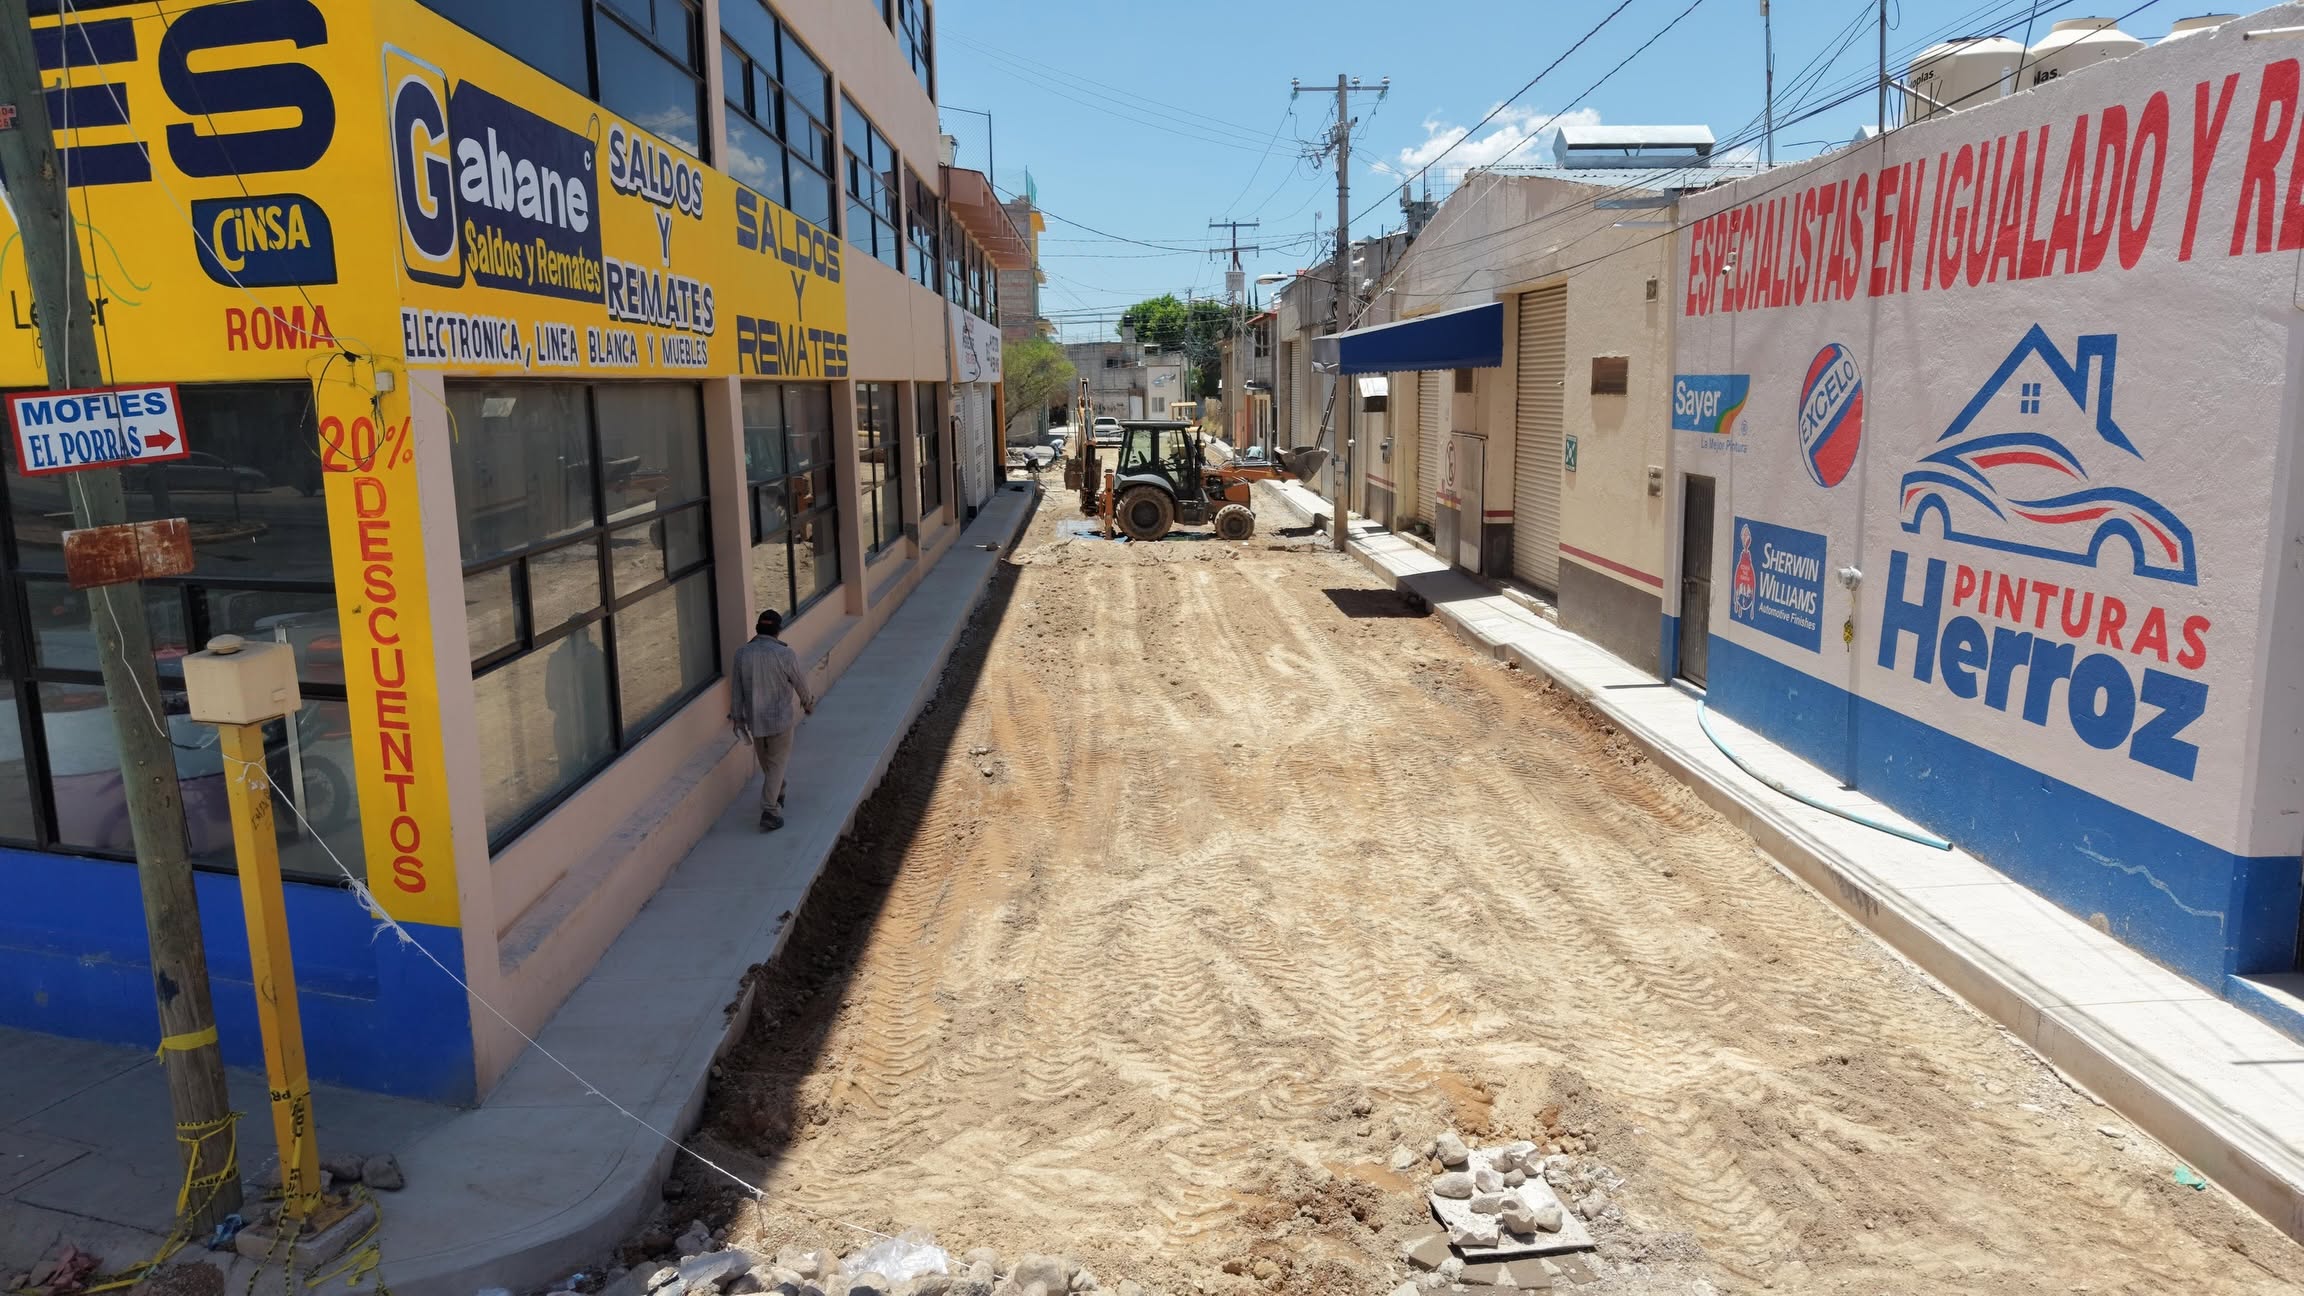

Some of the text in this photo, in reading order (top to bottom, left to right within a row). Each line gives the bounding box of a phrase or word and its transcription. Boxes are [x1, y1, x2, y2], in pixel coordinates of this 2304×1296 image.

[393, 74, 589, 262] Gabane
[609, 126, 703, 216] SALDOS
[1685, 174, 1871, 316] ESPECIALISTAS
[1868, 158, 1925, 298] EN
[1923, 91, 2169, 291] IGUALADO
[2178, 73, 2240, 261] Y
[656, 208, 671, 267] Y
[736, 187, 840, 284] SALDOS
[525, 241, 535, 286] y
[536, 237, 601, 294] Remates
[607, 258, 715, 335] REMATES
[790, 271, 807, 321] Y
[226, 306, 334, 351] ROMA
[536, 326, 579, 362] LINEA
[588, 330, 638, 363] BLANCA
[648, 340, 654, 363] Y
[662, 337, 708, 366] MUEBLES
[736, 315, 848, 377] REMATES
[21, 392, 168, 427] MOFLES
[1676, 381, 1721, 425] Sayer
[1801, 361, 1853, 445] EXCELO
[29, 425, 141, 467] EL PORRAS
[320, 416, 414, 473] 20%
[1762, 543, 1819, 582] SHERWIN
[1759, 602, 1815, 631] Automotive Finishes
[1760, 571, 1817, 614] WILLIAMS
[1953, 564, 2211, 670] PINTURAS
[354, 477, 426, 894] DESCUENTOS
[1877, 549, 2210, 782] Herroz
